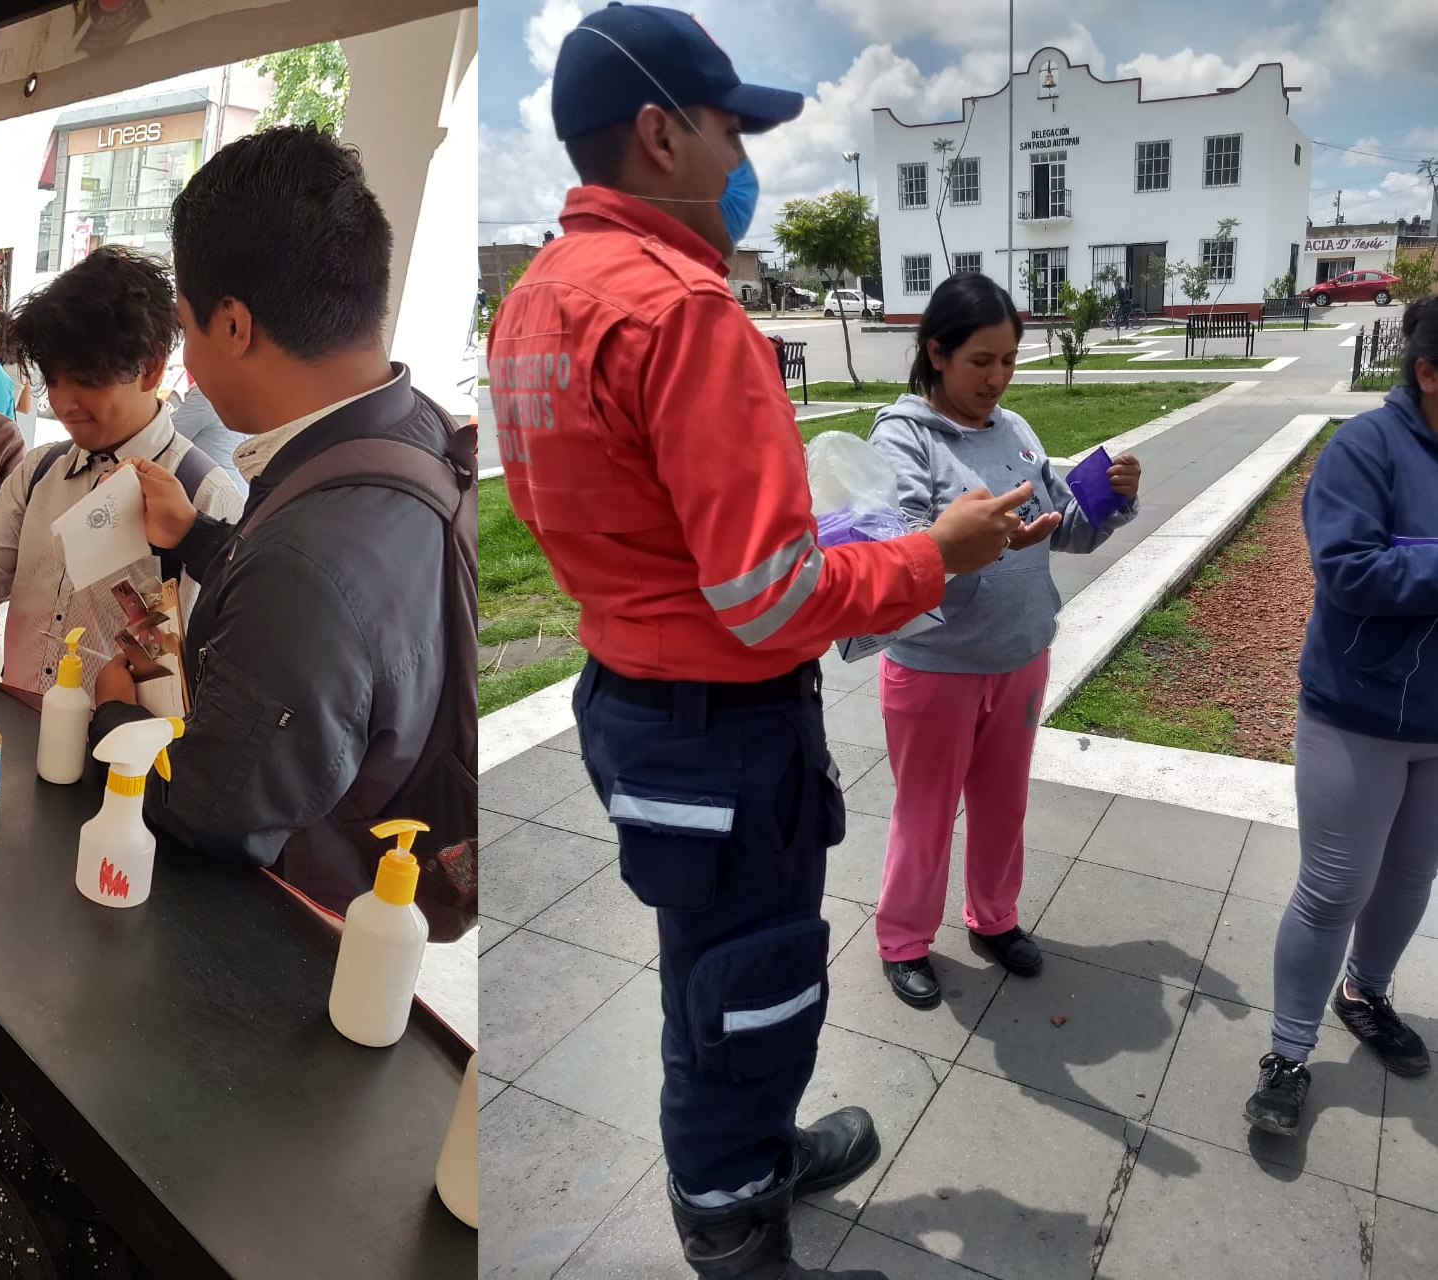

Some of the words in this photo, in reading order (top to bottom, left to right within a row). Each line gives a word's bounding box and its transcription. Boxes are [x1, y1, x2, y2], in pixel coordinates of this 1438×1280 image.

[1020, 142, 1031, 150] SAN
[1032, 140, 1051, 149] PABLO
[1053, 137, 1080, 147] AUTOPAN
